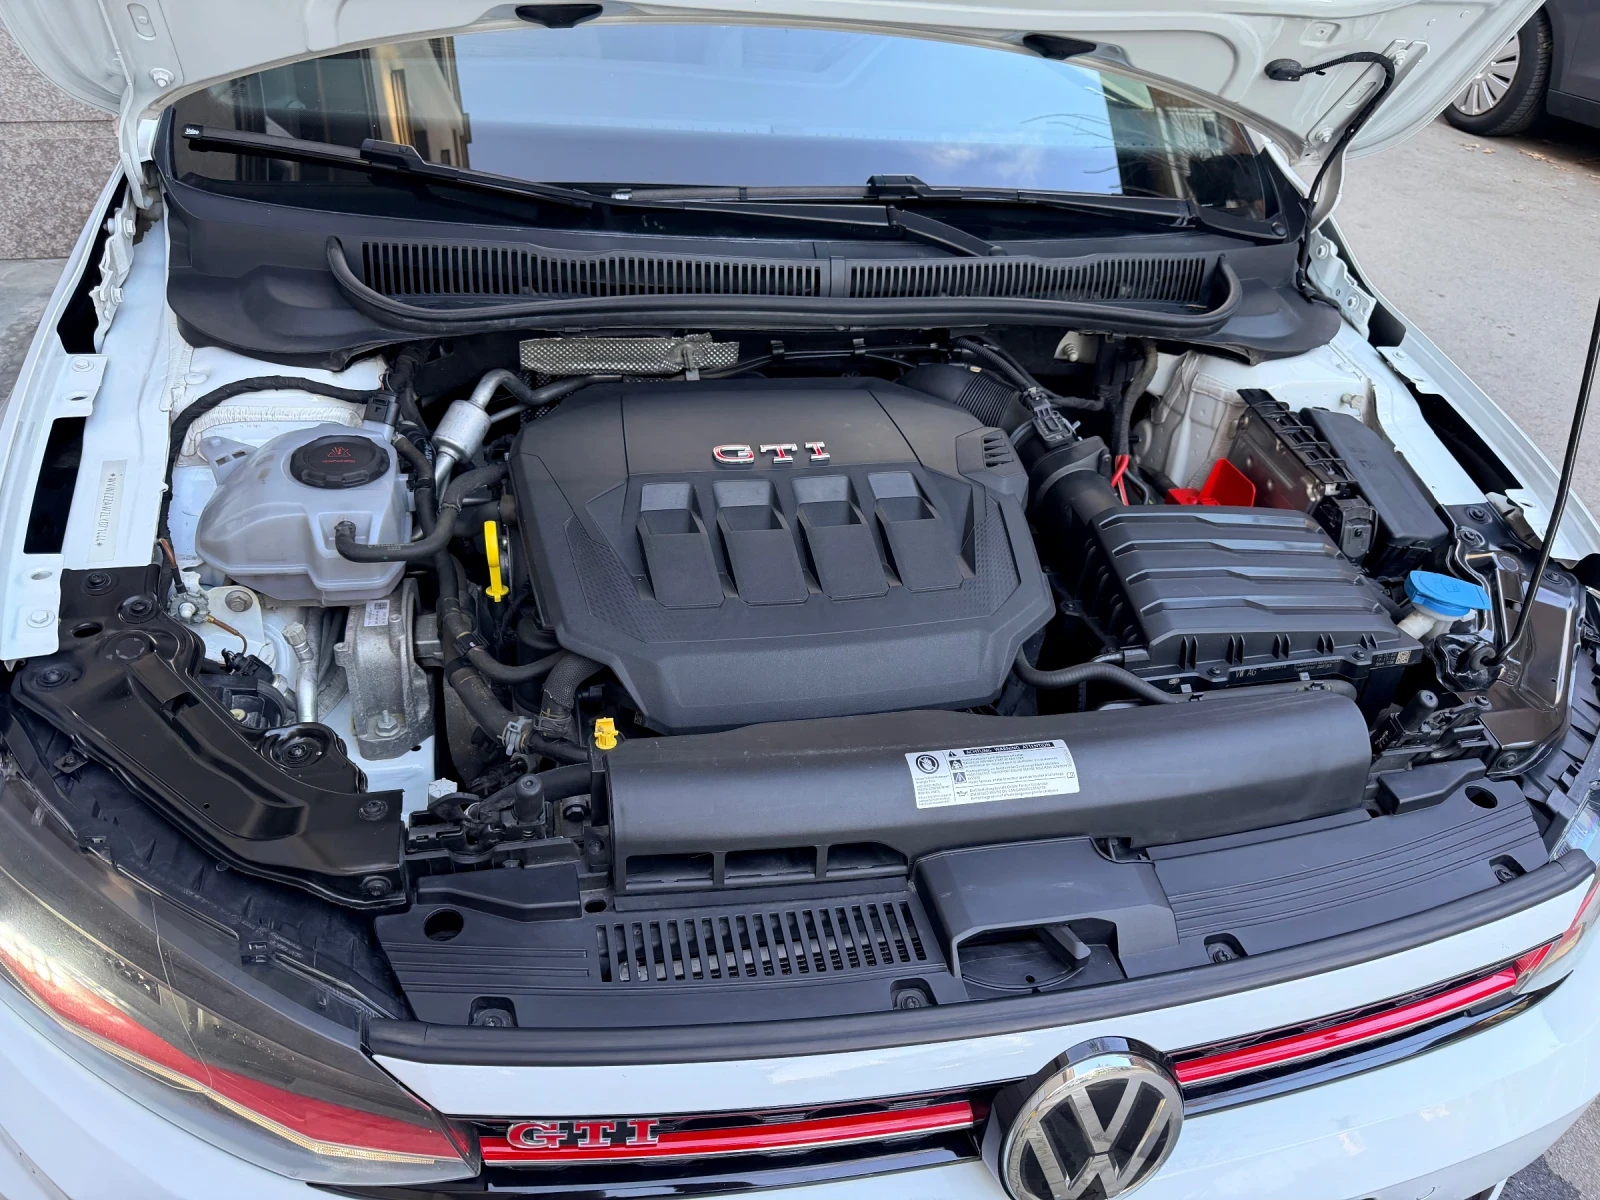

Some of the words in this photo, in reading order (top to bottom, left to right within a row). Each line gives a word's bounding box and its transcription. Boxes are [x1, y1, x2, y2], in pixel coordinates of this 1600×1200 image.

[712, 441, 831, 464] GTI
[506, 1119, 660, 1149] GTI
[1012, 1066, 1178, 1200] VW
